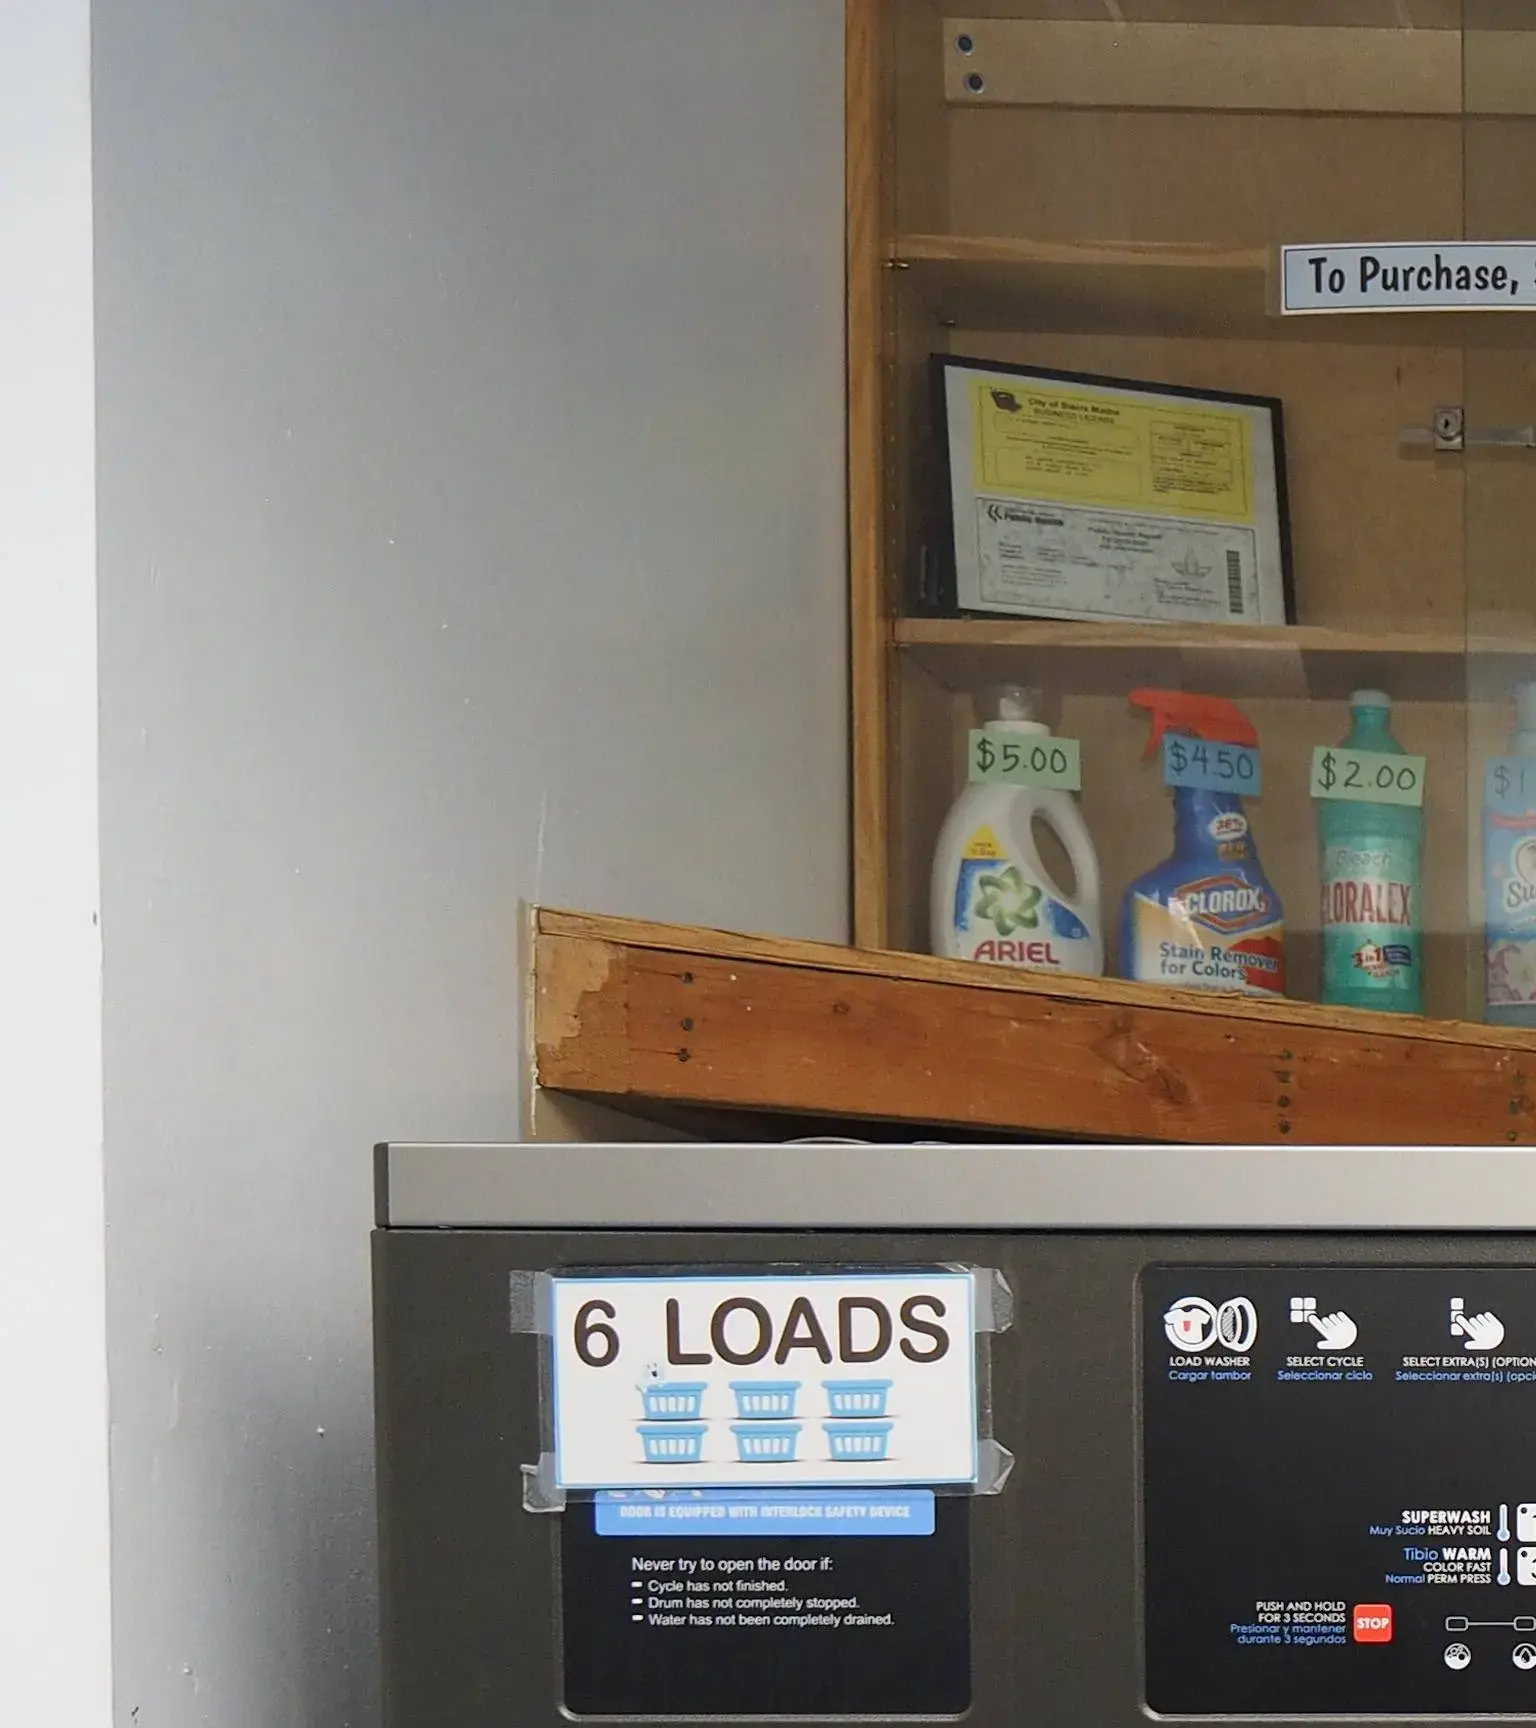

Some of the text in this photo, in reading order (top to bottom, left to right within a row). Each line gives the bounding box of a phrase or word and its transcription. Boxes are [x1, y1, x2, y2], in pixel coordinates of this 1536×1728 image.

[1309, 258, 1345, 294] To
[1360, 254, 1519, 297] Purchase,
[976, 738, 1068, 774] $5.00
[1318, 752, 1416, 791] $2.00
[1186, 888, 1260, 914] CLOROX
[974, 940, 1061, 965] ARIEL
[1160, 942, 1278, 974] Stain Remover
[1160, 960, 1247, 981] for Colors
[574, 1295, 950, 1367] 6 LOADS
[1169, 1356, 1250, 1367] LOAD WASHER
[1287, 1356, 1364, 1367] SELECT CYCLE
[1403, 1356, 1440, 1368] SELECT
[1442, 1356, 1489, 1369] EXTRA(S)
[620, 1505, 910, 1518] DOOR IS EQUIPPED WITH INTERLOCK SAFETY DEVICE
[1401, 1510, 1491, 1524] SUPERWASH
[1404, 1548, 1491, 1561] Tibio WARM
[632, 1557, 833, 1574] Never try to open the door if:
[648, 1579, 788, 1593] Cycle has not finished.
[648, 1597, 860, 1612] Drum has not completely stopped.
[1256, 1601, 1346, 1611] PUSH AND HOLD
[648, 1613, 895, 1628] Water has not been completely drained.
[1258, 1613, 1346, 1623] FOR 3 SECONDS
[1356, 1617, 1390, 1629] STOP
